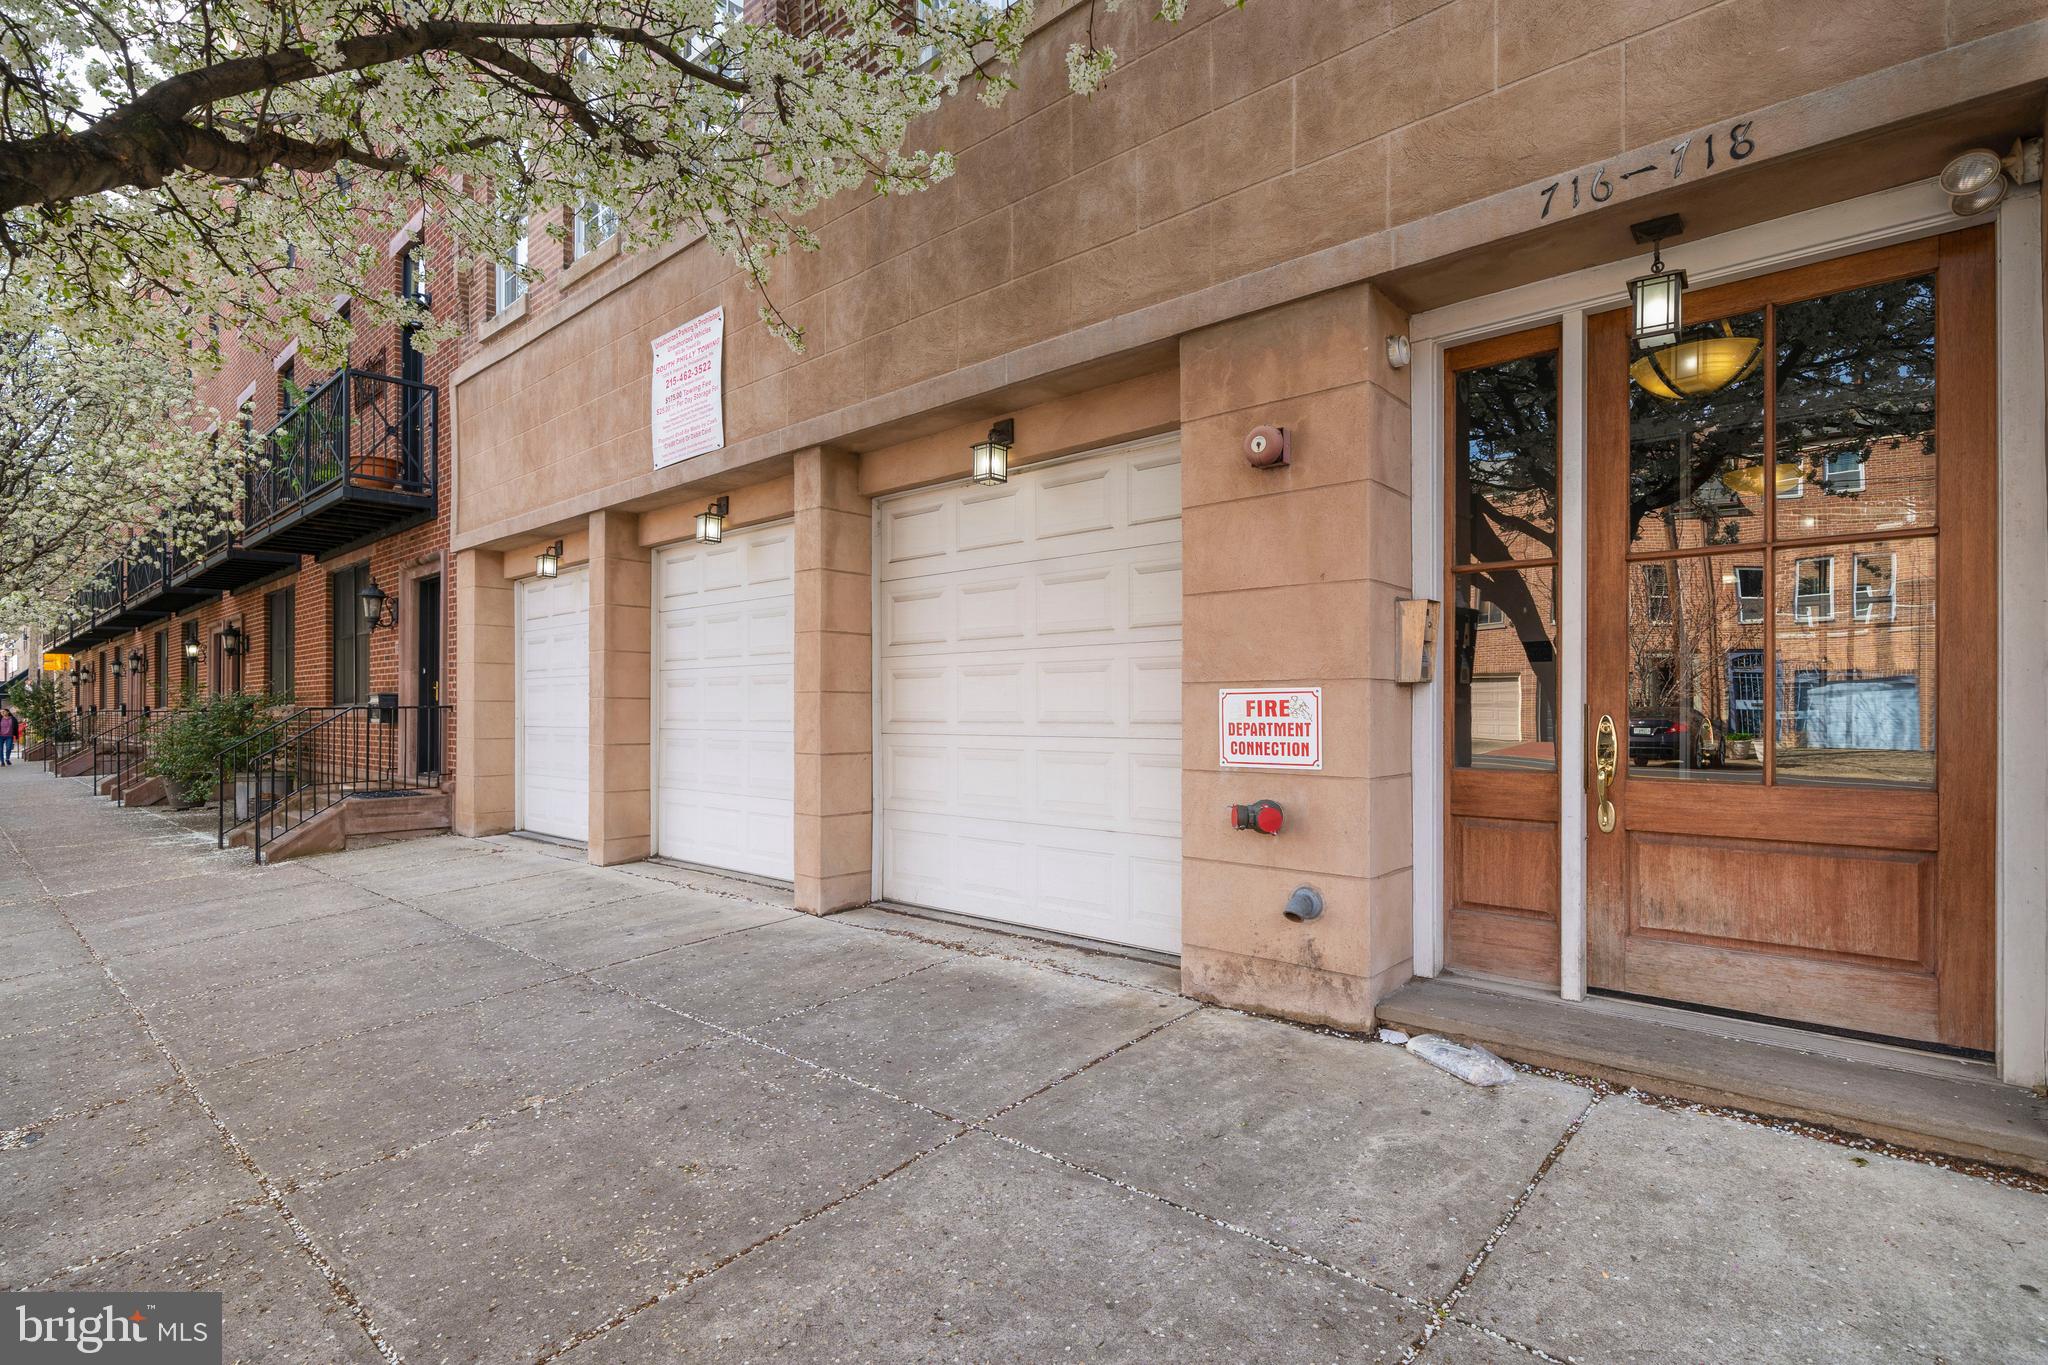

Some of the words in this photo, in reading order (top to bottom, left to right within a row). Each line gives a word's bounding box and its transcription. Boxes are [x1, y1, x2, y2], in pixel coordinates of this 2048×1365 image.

[1540, 120, 1756, 219] 716-718
[678, 325, 694, 338] Parking
[698, 311, 720, 325] Prohibited
[656, 361, 675, 374] SOUTH
[676, 350, 696, 364] PHILLY
[697, 337, 720, 354] TOWING
[665, 360, 712, 389] 215-462-3522
[683, 383, 702, 396] Towing
[693, 388, 712, 400] Storage
[1246, 699, 1290, 717] FIRE
[1228, 722, 1312, 737] DEPARTMENT
[1230, 741, 1310, 757] CONNECTION
